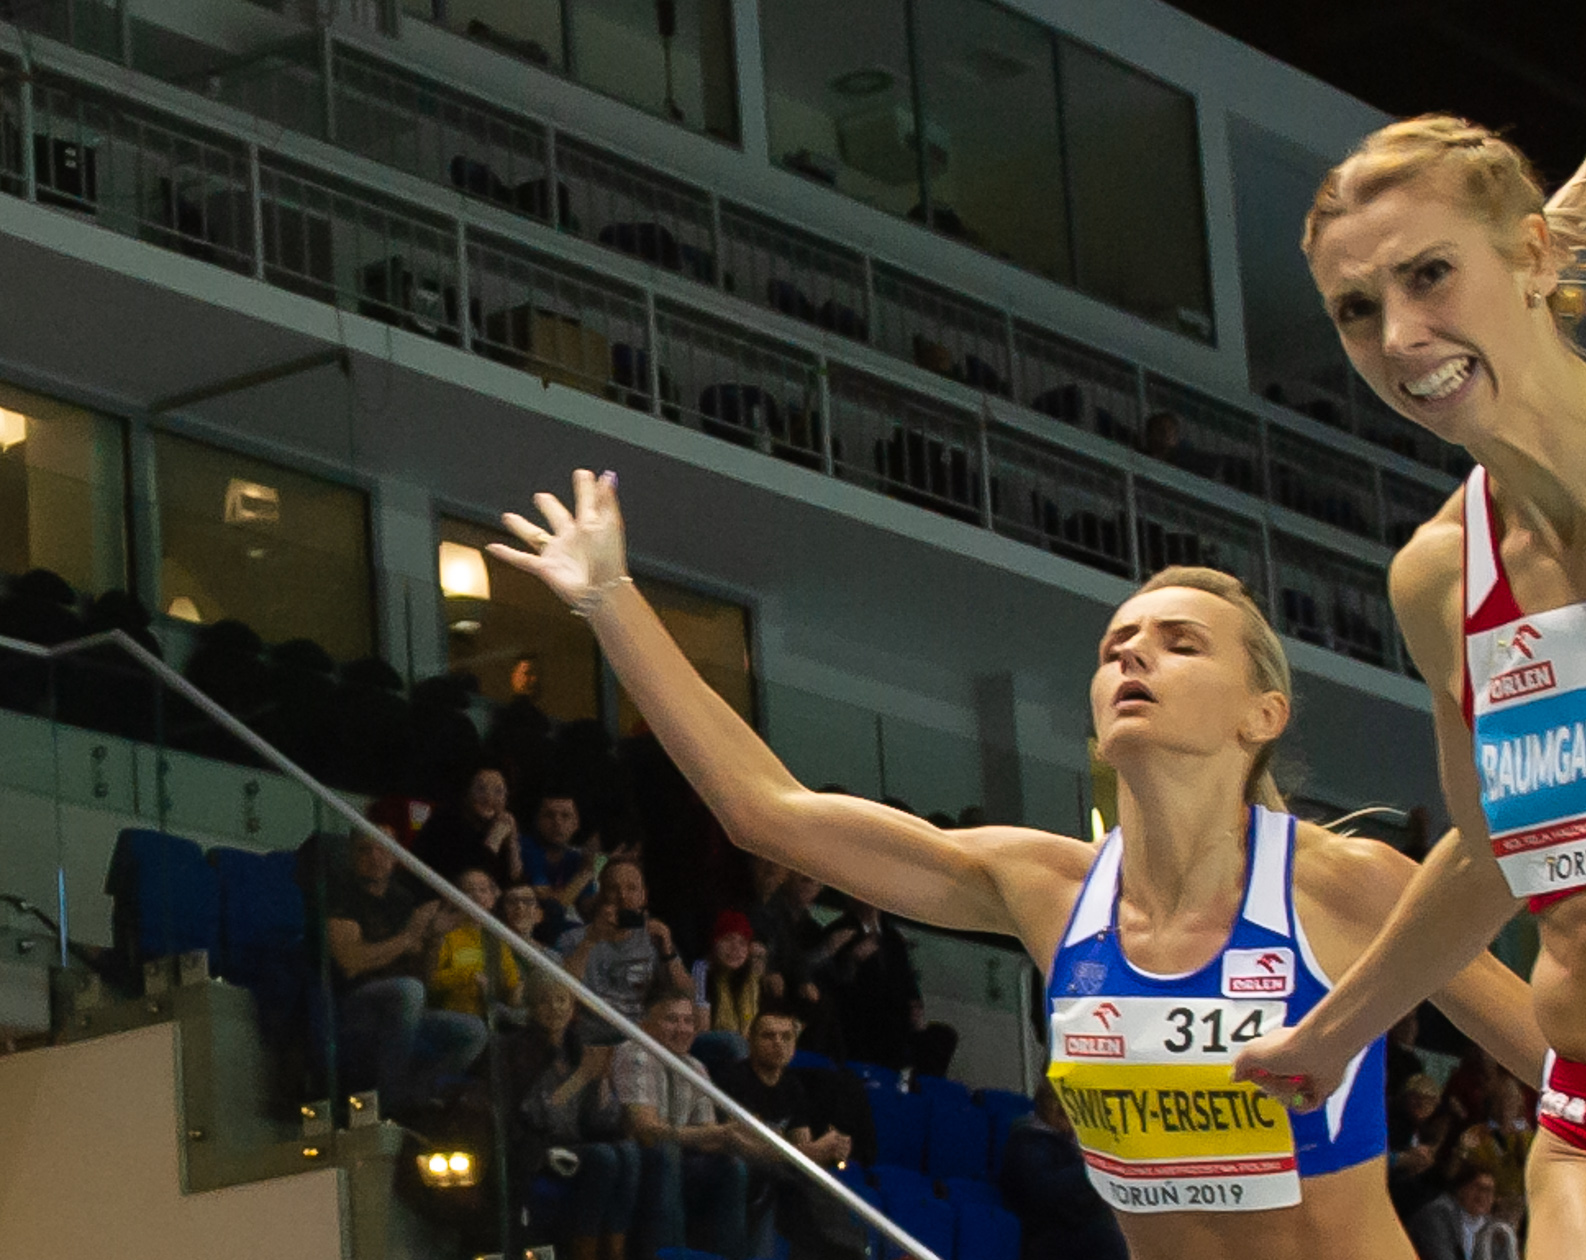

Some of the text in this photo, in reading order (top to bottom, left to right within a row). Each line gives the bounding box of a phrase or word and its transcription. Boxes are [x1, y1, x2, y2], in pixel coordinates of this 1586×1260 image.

[1490, 664, 1553, 701] ORLEN
[1164, 1007, 1263, 1053] 314
[1187, 1183, 1244, 1207] 2019
